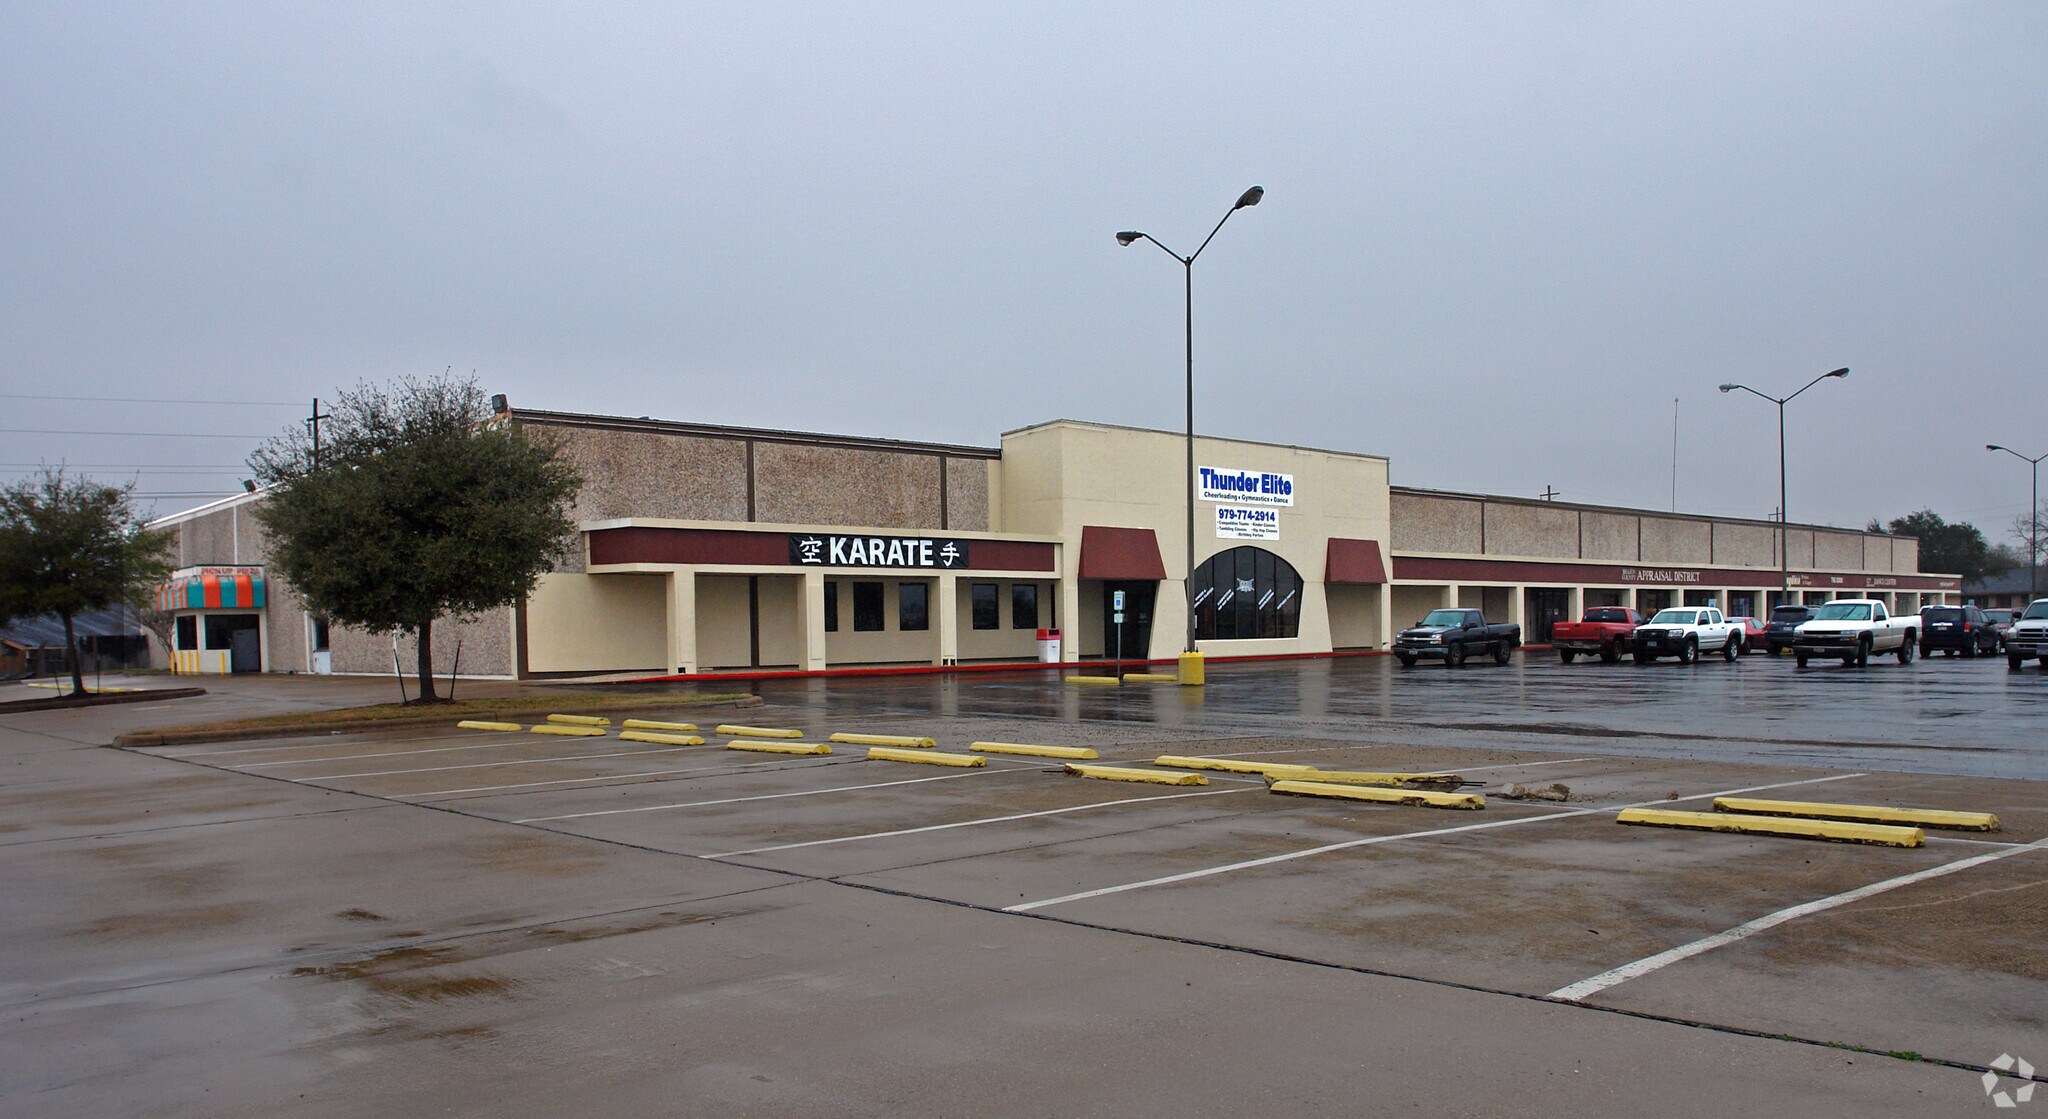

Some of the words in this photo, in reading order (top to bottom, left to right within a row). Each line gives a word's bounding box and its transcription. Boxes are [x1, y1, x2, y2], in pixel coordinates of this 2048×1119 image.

[1200, 468, 1259, 492] Thunder
[1261, 474, 1292, 495] Elite
[1204, 491, 1237, 501] Cheerleading
[1241, 494, 1270, 502] Gymnastics
[1219, 509, 1275, 521] 979-774-2914
[800, 536, 823, 564] 空
[830, 537, 934, 566] KARATE
[940, 541, 960, 568] 手
[1637, 570, 1673, 581] APPRAISAL
[1674, 571, 1700, 582] DISTRICT
